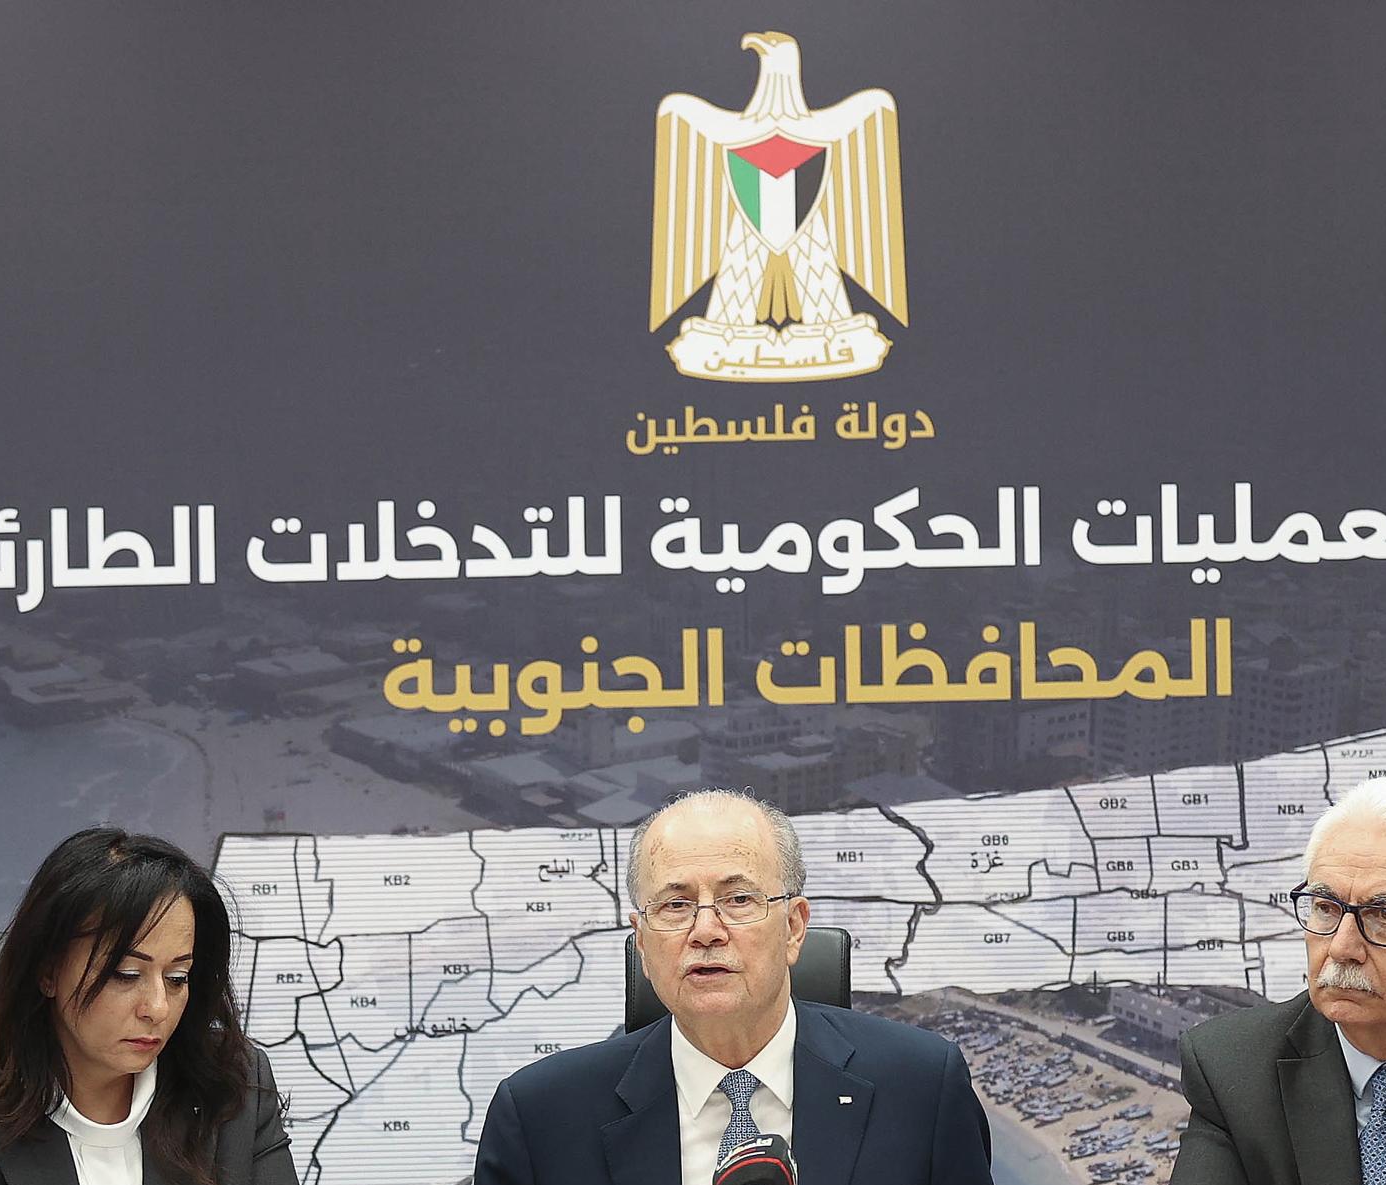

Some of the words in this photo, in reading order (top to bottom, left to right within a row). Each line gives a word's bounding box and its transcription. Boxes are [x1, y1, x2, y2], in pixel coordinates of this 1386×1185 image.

[704, 338, 854, 376] فلسطين
[625, 404, 816, 455] فلسطين
[835, 401, 936, 450] دولة
[246, 495, 623, 585] للتدخلات
[649, 484, 1041, 594] الحكومية
[755, 616, 1234, 705] المحافظات
[383, 627, 725, 737] الجنوبية
[1099, 798, 1128, 810] GB2
[1182, 793, 1209, 805] GB1
[1277, 804, 1305, 816] NB4
[836, 851, 864, 863] MB1
[970, 850, 1004, 874] غزة
[538, 858, 575, 882] البلح
[1171, 860, 1199, 871] GB3
[384, 874, 412, 887] KB2
[252, 884, 278, 895] RB1
[1269, 892, 1292, 906] NB
[525, 902, 553, 912] KB1
[984, 933, 1011, 944] GB7
[1106, 931, 1135, 942] GB5
[443, 964, 470, 975] KB3
[276, 973, 303, 985] RB2
[351, 997, 377, 1008] KB4
[383, 1121, 410, 1132] KB6
